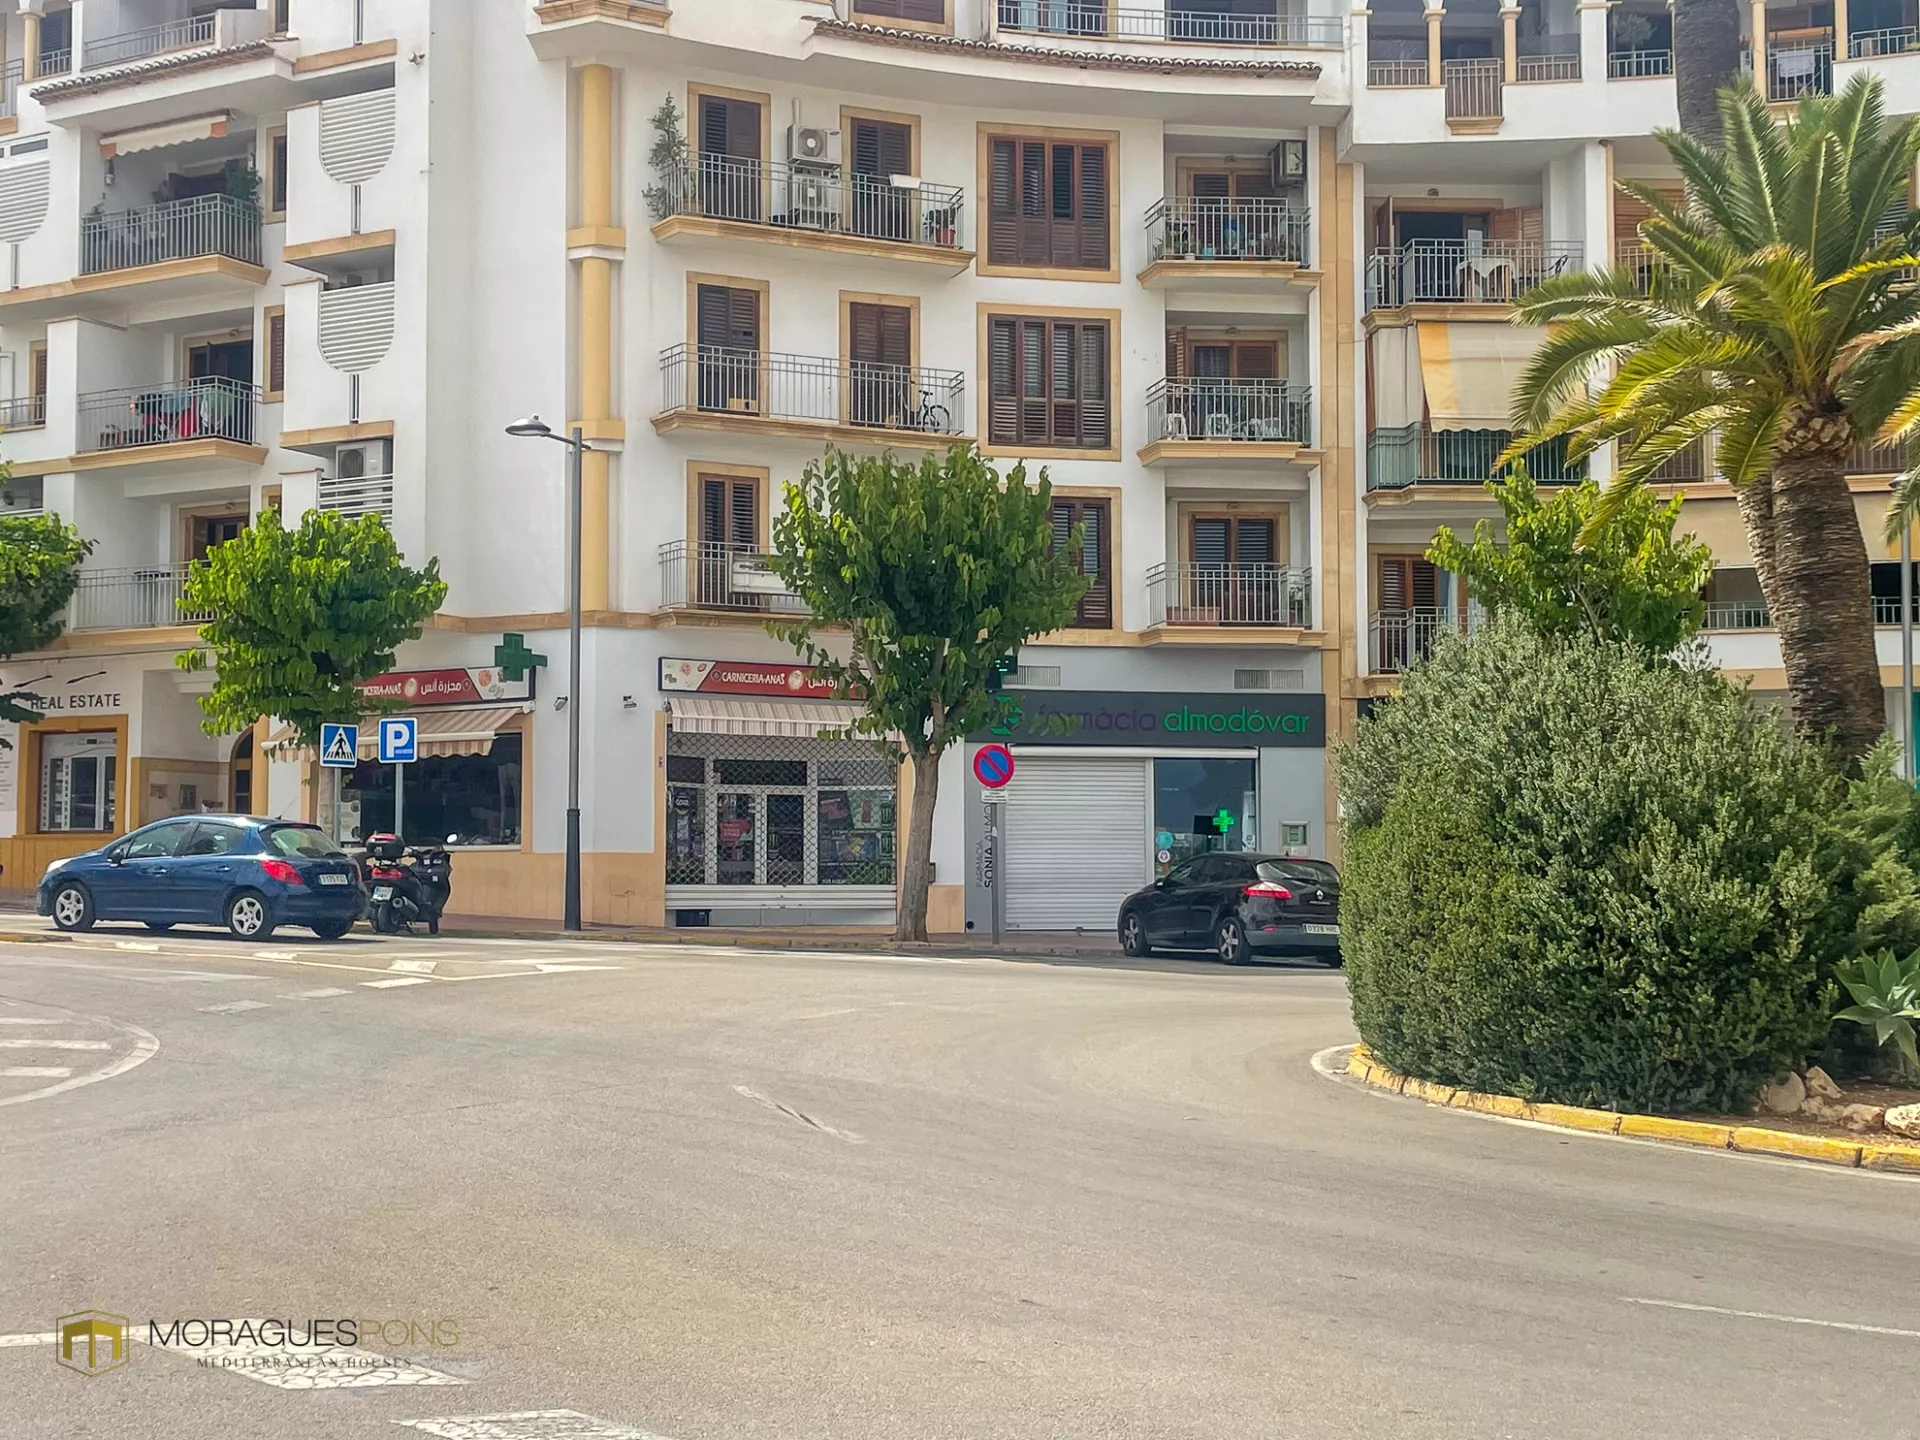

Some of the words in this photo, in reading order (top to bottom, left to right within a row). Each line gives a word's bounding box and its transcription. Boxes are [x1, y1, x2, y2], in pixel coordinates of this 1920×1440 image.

[30, 696, 64, 710] REAL
[69, 693, 122, 709] ESTATE
[1163, 705, 1310, 733] almodóvar
[386, 723, 410, 758] P
[983, 804, 993, 843] ALMO
[983, 847, 993, 888] SONIA
